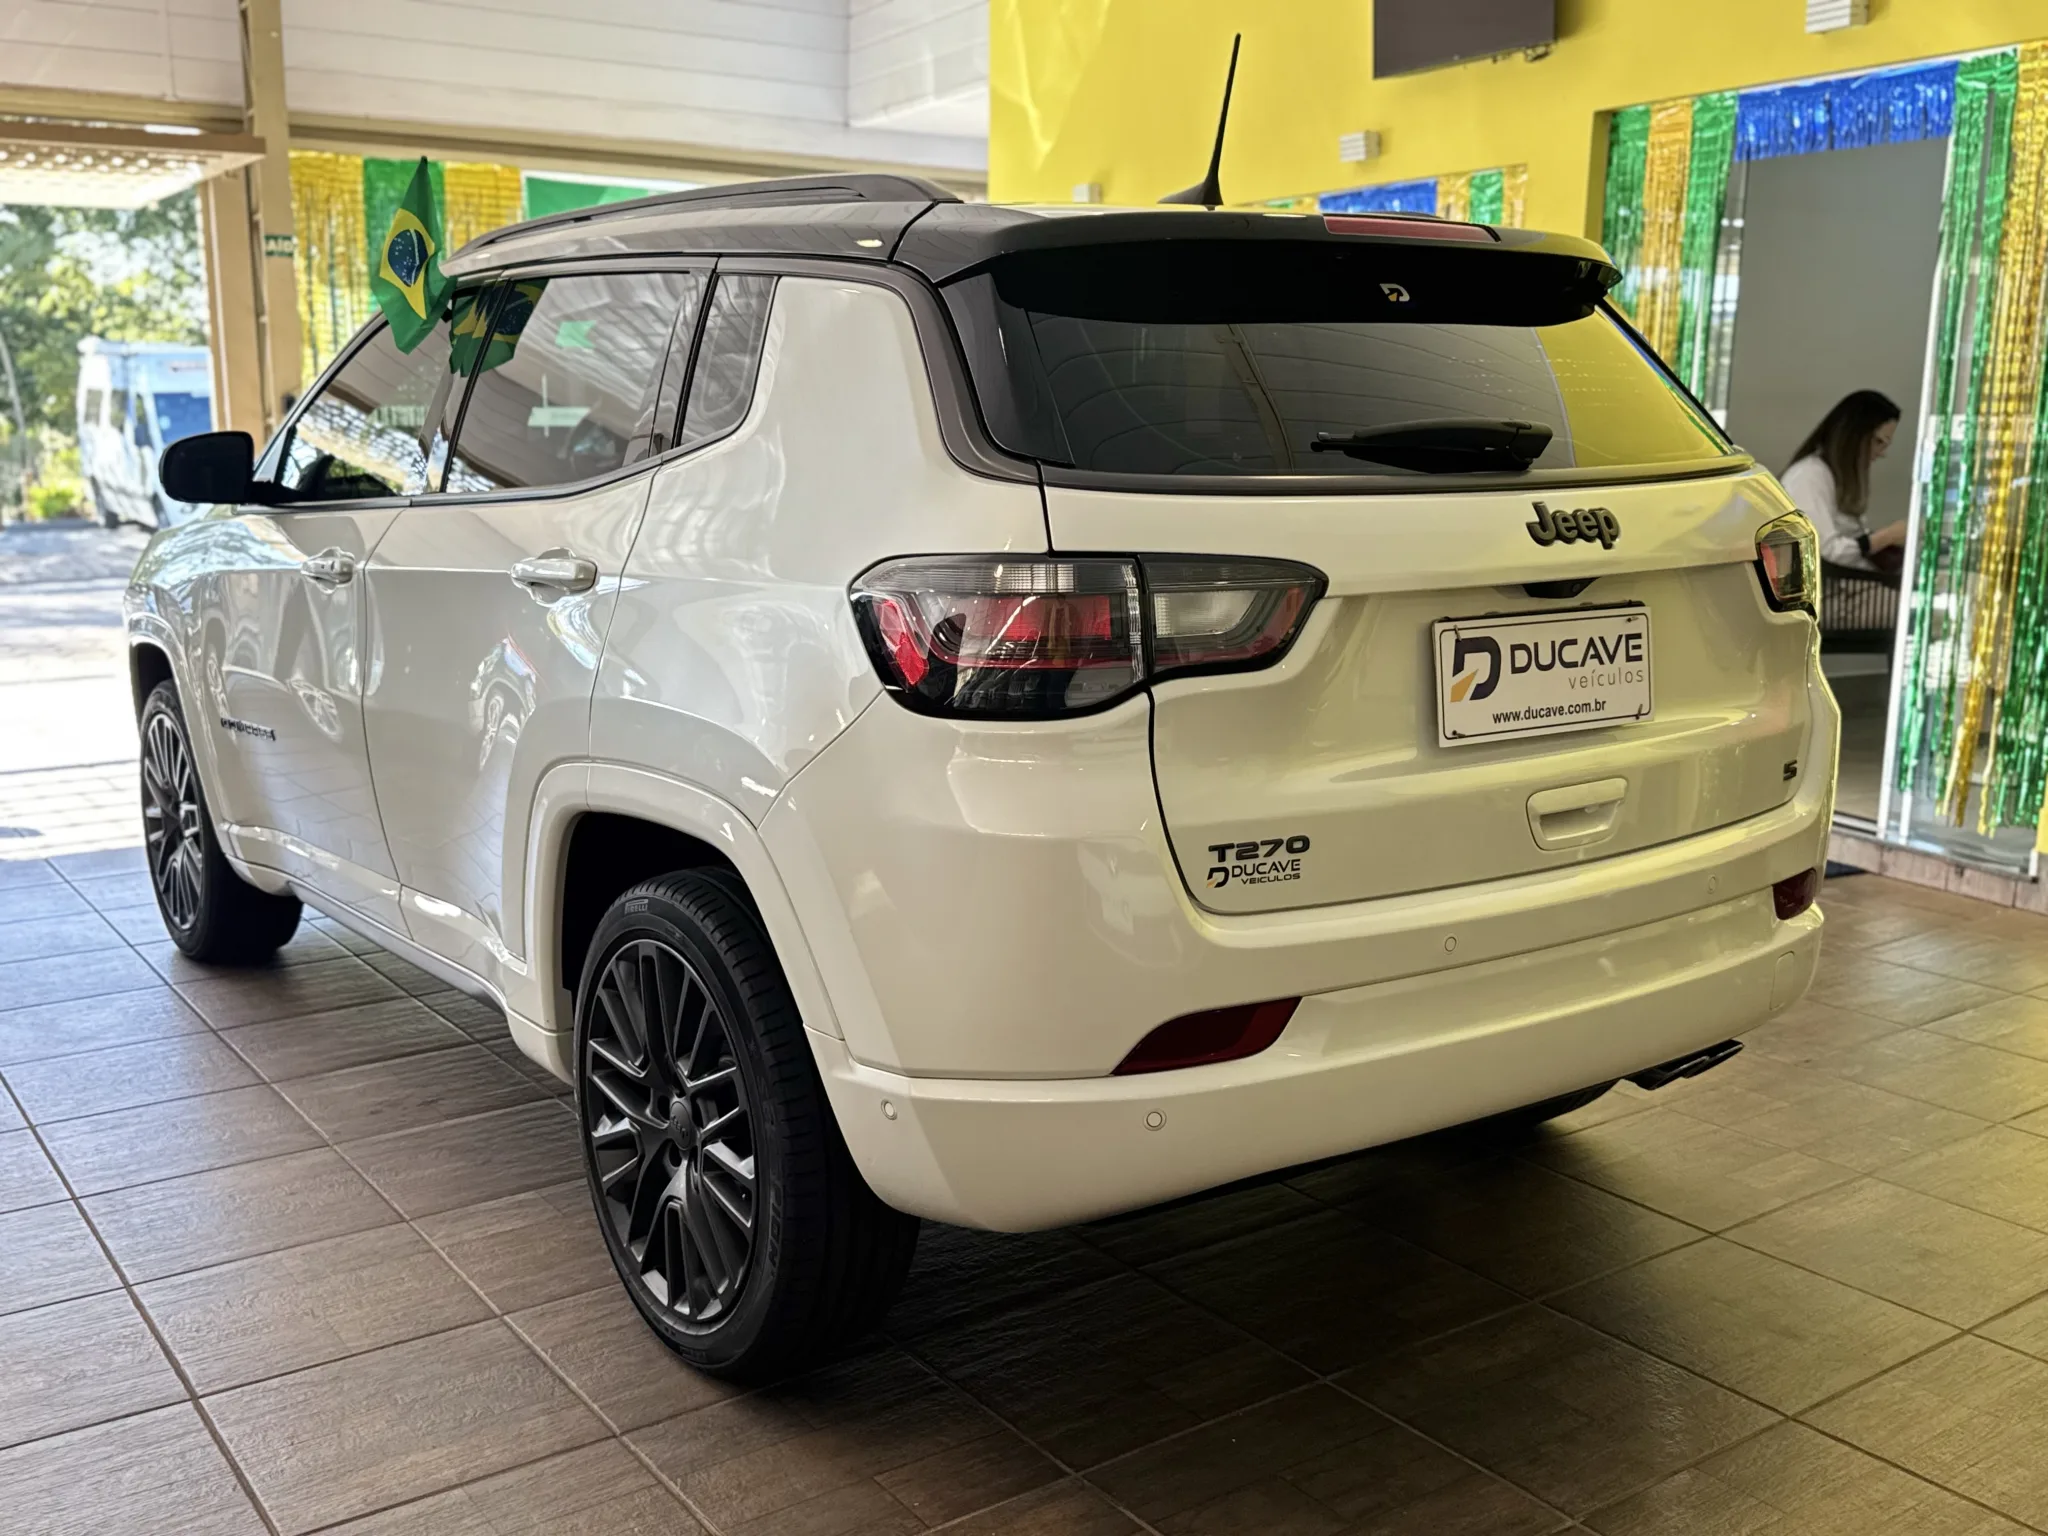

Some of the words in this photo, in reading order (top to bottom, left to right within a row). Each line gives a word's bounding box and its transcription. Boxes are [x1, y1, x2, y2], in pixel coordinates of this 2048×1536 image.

[1525, 501, 1620, 550] Jeep
[1510, 632, 1643, 674] DUCAVE
[1568, 667, 1644, 690] veículos
[1492, 698, 1607, 724] www.ducave.com.br
[1208, 834, 1310, 863] T270
[1231, 858, 1301, 878] DUCAVE
[1240, 872, 1302, 885] VEICULOS
